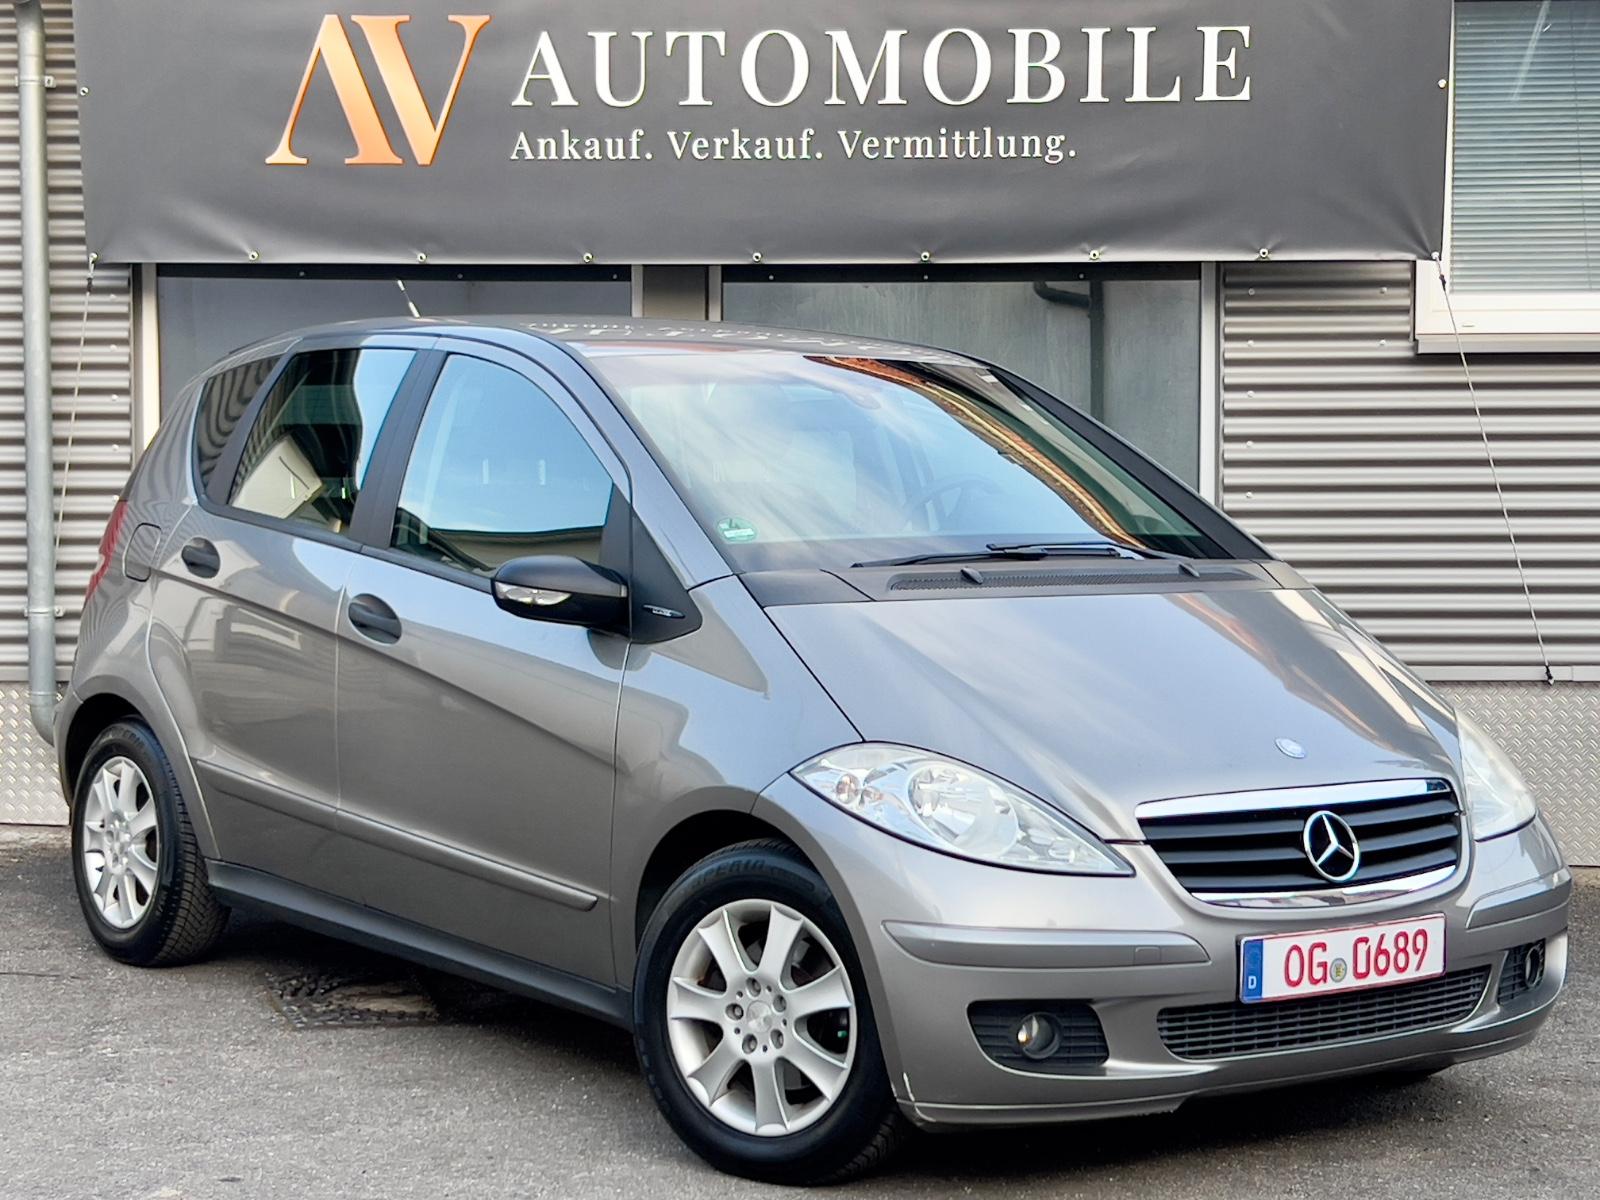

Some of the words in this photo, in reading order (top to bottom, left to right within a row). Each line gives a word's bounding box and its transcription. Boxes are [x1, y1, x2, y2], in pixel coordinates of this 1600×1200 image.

[265, 14, 491, 166] AV
[512, 26, 1250, 107] AUTOMOBILE
[510, 129, 652, 159] Ankauf.
[667, 128, 822, 159] Verkauf.
[838, 127, 1075, 163] Vermittlung.
[1284, 942, 1328, 987] OG
[1353, 928, 1428, 980] 0689
[1248, 975, 1257, 990] D
